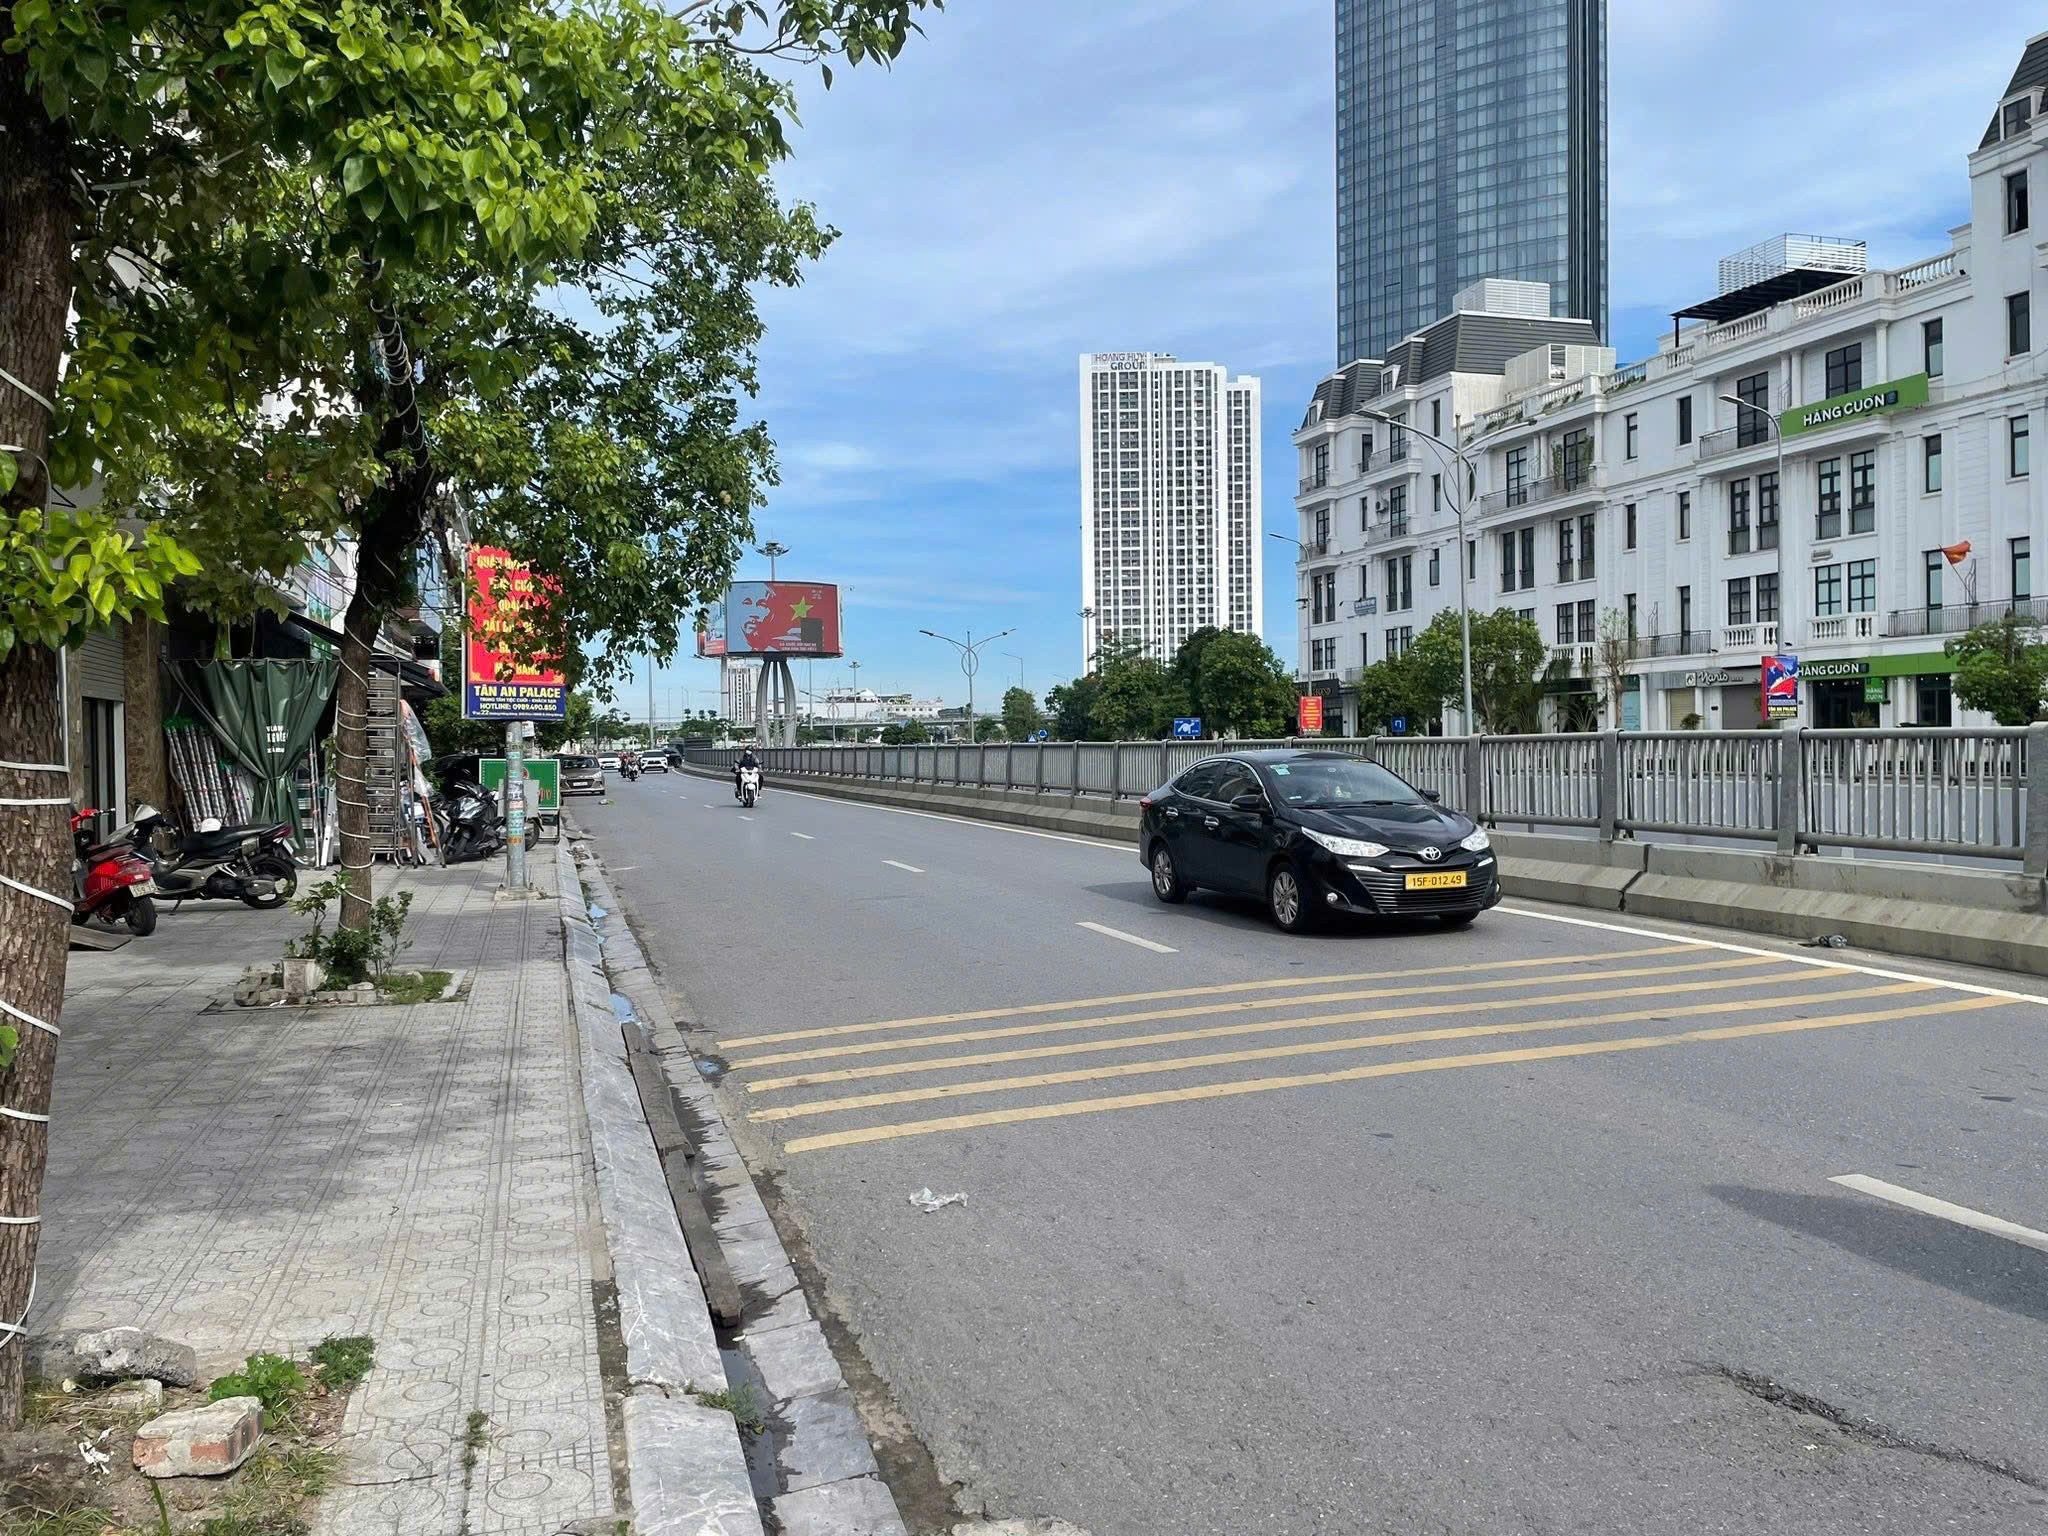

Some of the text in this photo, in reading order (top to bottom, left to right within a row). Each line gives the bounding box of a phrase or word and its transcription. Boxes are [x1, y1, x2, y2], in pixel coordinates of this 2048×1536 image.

[1110, 361, 1146, 371] GROUP
[474, 684, 561, 698] TÂN AN PALACE
